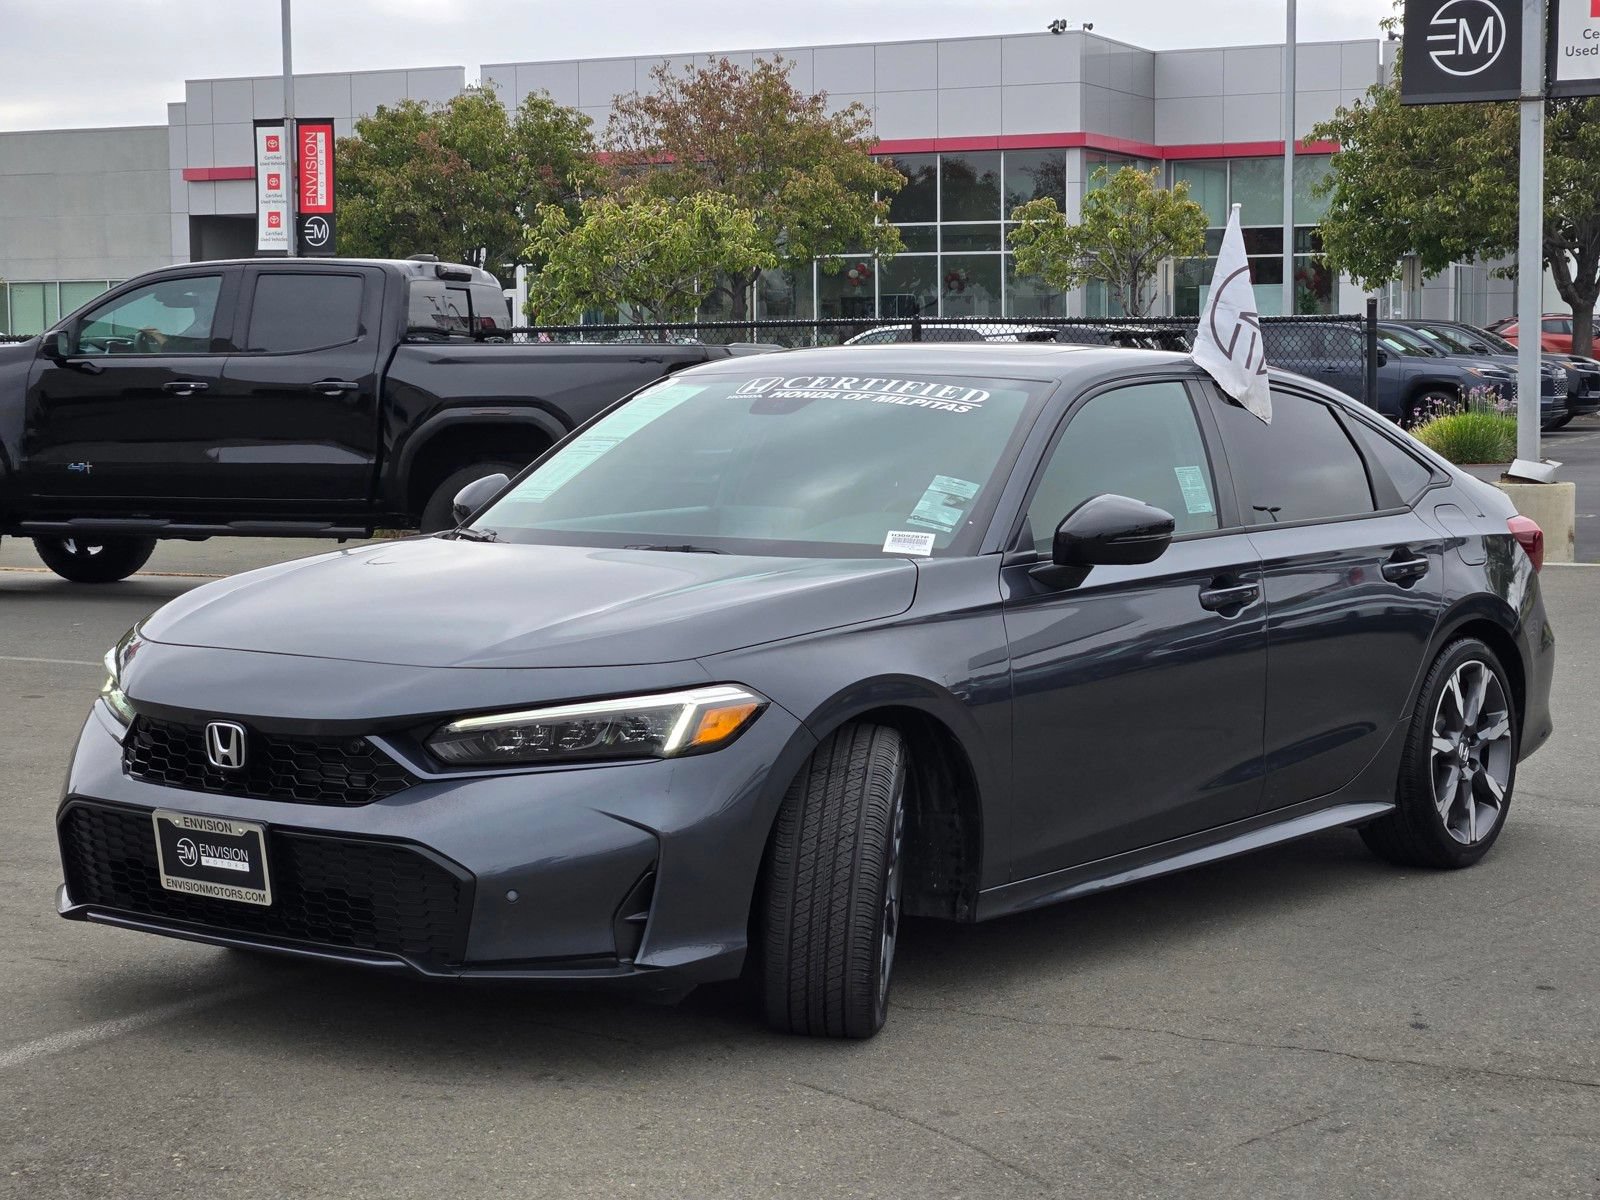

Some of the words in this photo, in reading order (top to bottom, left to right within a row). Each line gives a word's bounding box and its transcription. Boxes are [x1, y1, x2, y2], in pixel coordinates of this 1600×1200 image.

[1565, 43, 1599, 57] Used
[305, 132, 318, 207] ENVISION
[783, 376, 990, 403] CERTIFIED
[768, 391, 840, 399] HONDA
[872, 395, 973, 413] MILPITAS
[183, 816, 233, 834] ENVISION
[199, 843, 249, 862] ENVISION
[205, 859, 246, 870] MOTORS
[166, 878, 267, 903] ENVISIONMOTORS.COM
